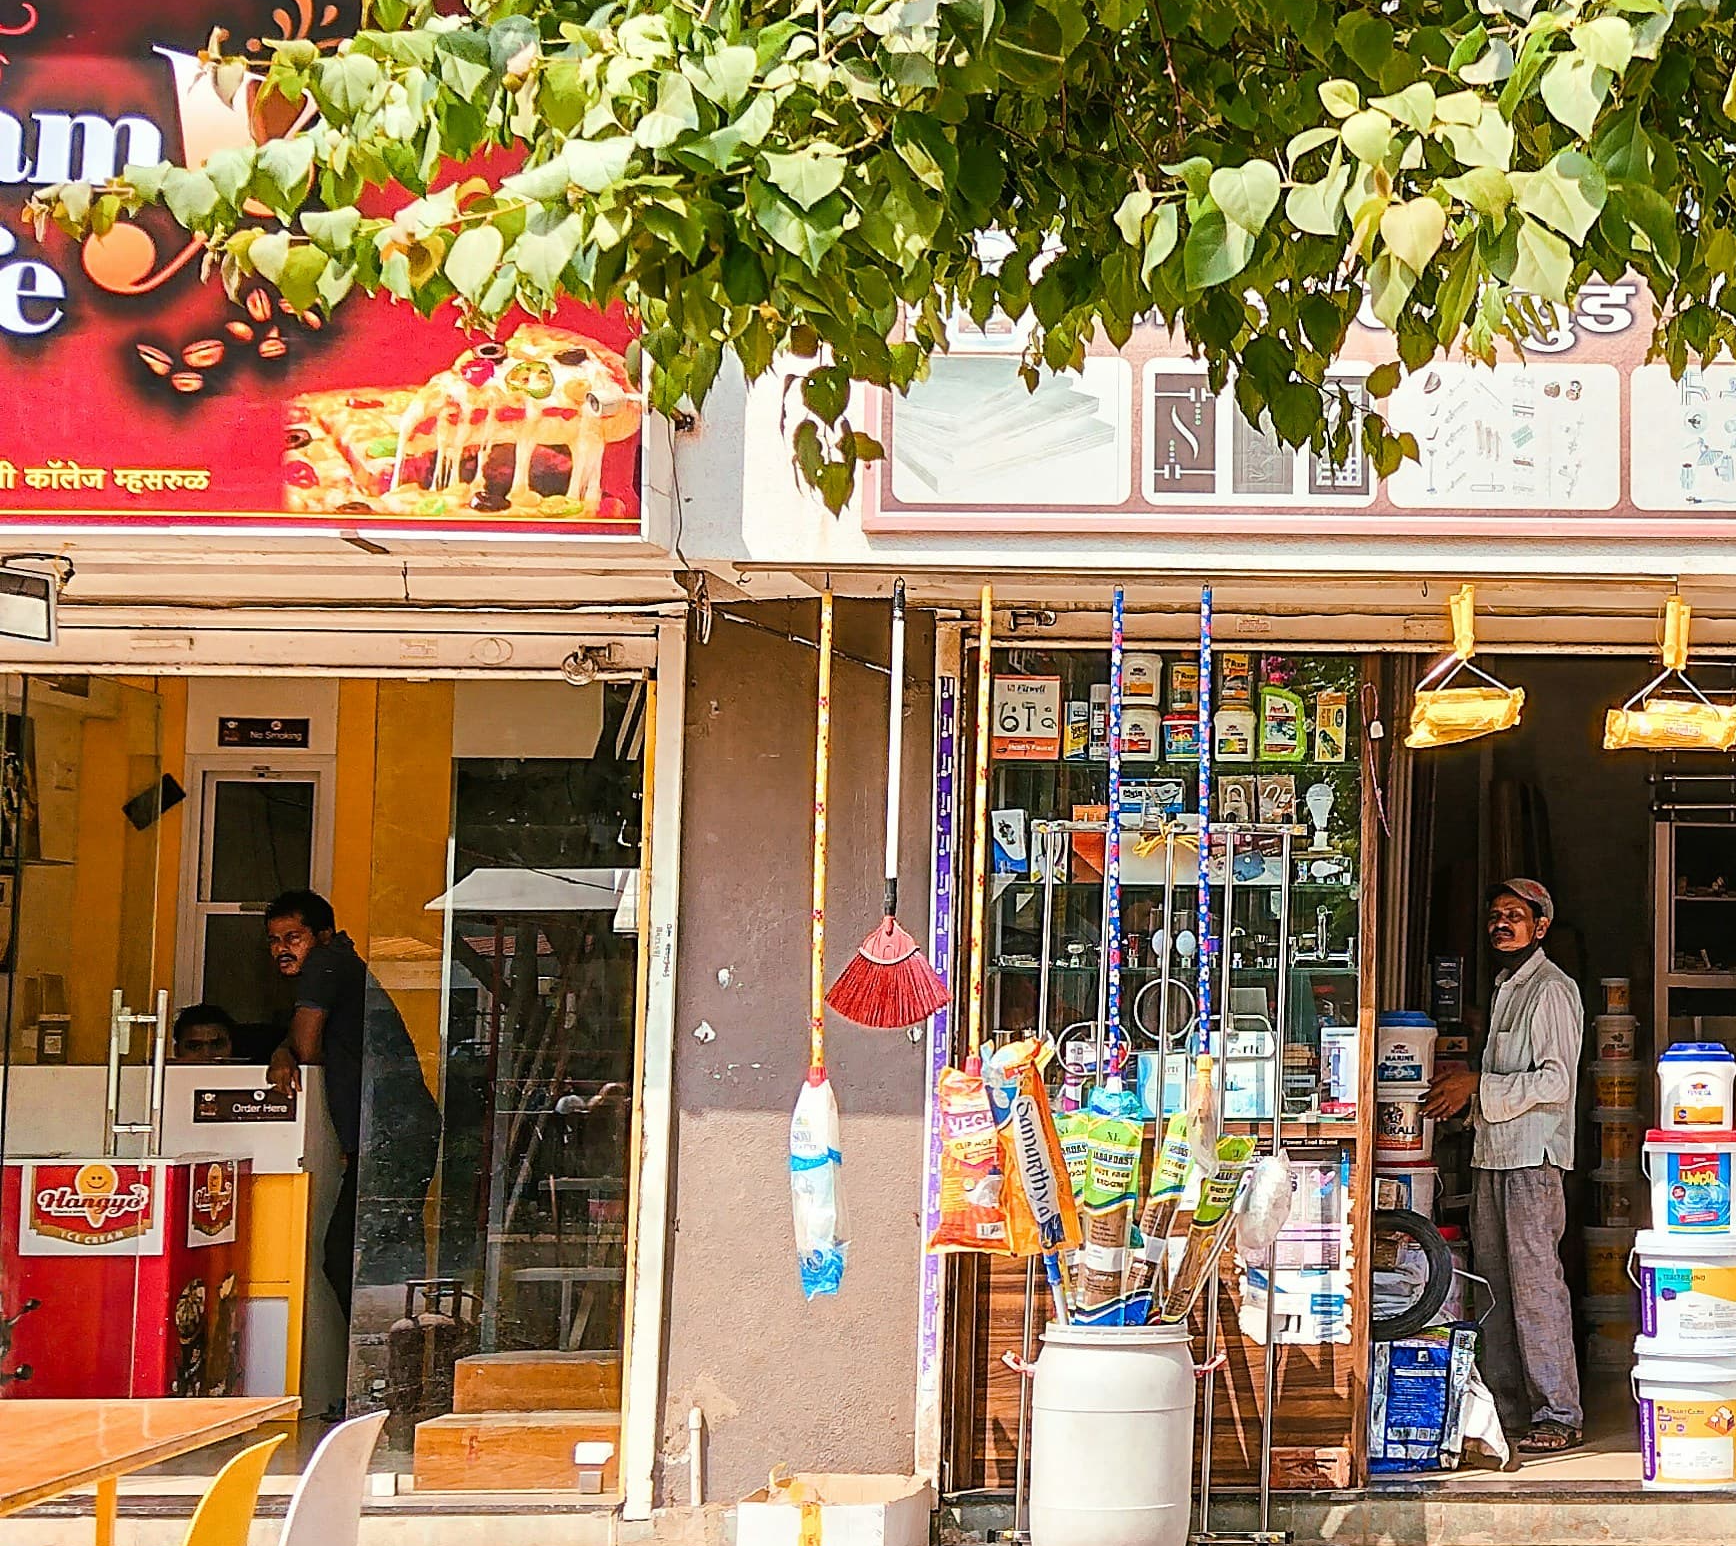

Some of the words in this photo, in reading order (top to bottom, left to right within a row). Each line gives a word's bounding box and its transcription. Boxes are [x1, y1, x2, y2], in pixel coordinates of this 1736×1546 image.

[24, 460, 105, 490] कॉलेज
[265, 731, 302, 741] Smoking
[232, 1103, 262, 1113] Order
[263, 1103, 288, 1113] Here
